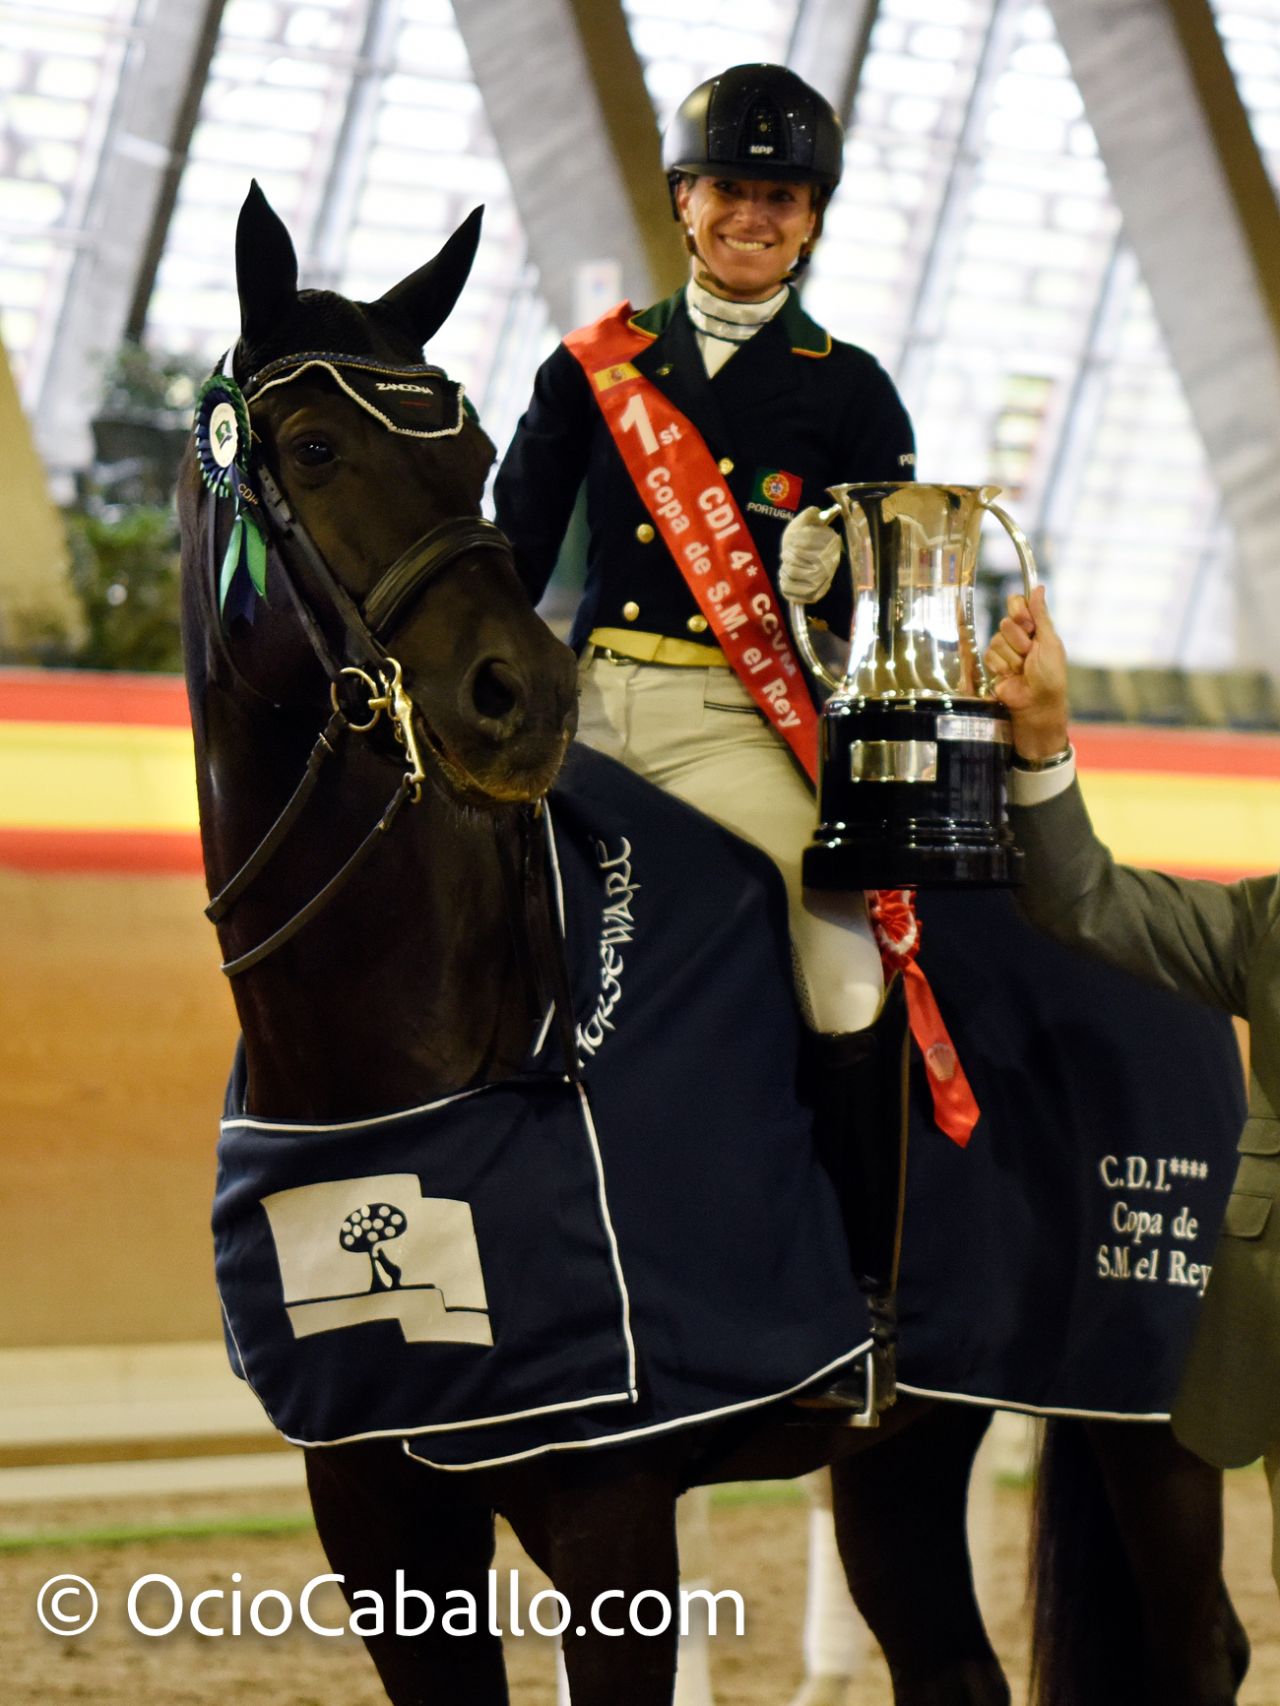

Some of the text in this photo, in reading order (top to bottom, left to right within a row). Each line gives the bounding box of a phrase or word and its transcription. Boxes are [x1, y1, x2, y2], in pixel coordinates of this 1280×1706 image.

[620, 393, 682, 456] 1st
[699, 486, 741, 541] CDI
[646, 466, 801, 728] Copa de S.M. el Rey
[1112, 1201, 1199, 1244] Copa de
[1134, 1249, 1160, 1281] el
[1168, 1250, 1212, 1297] Rey
